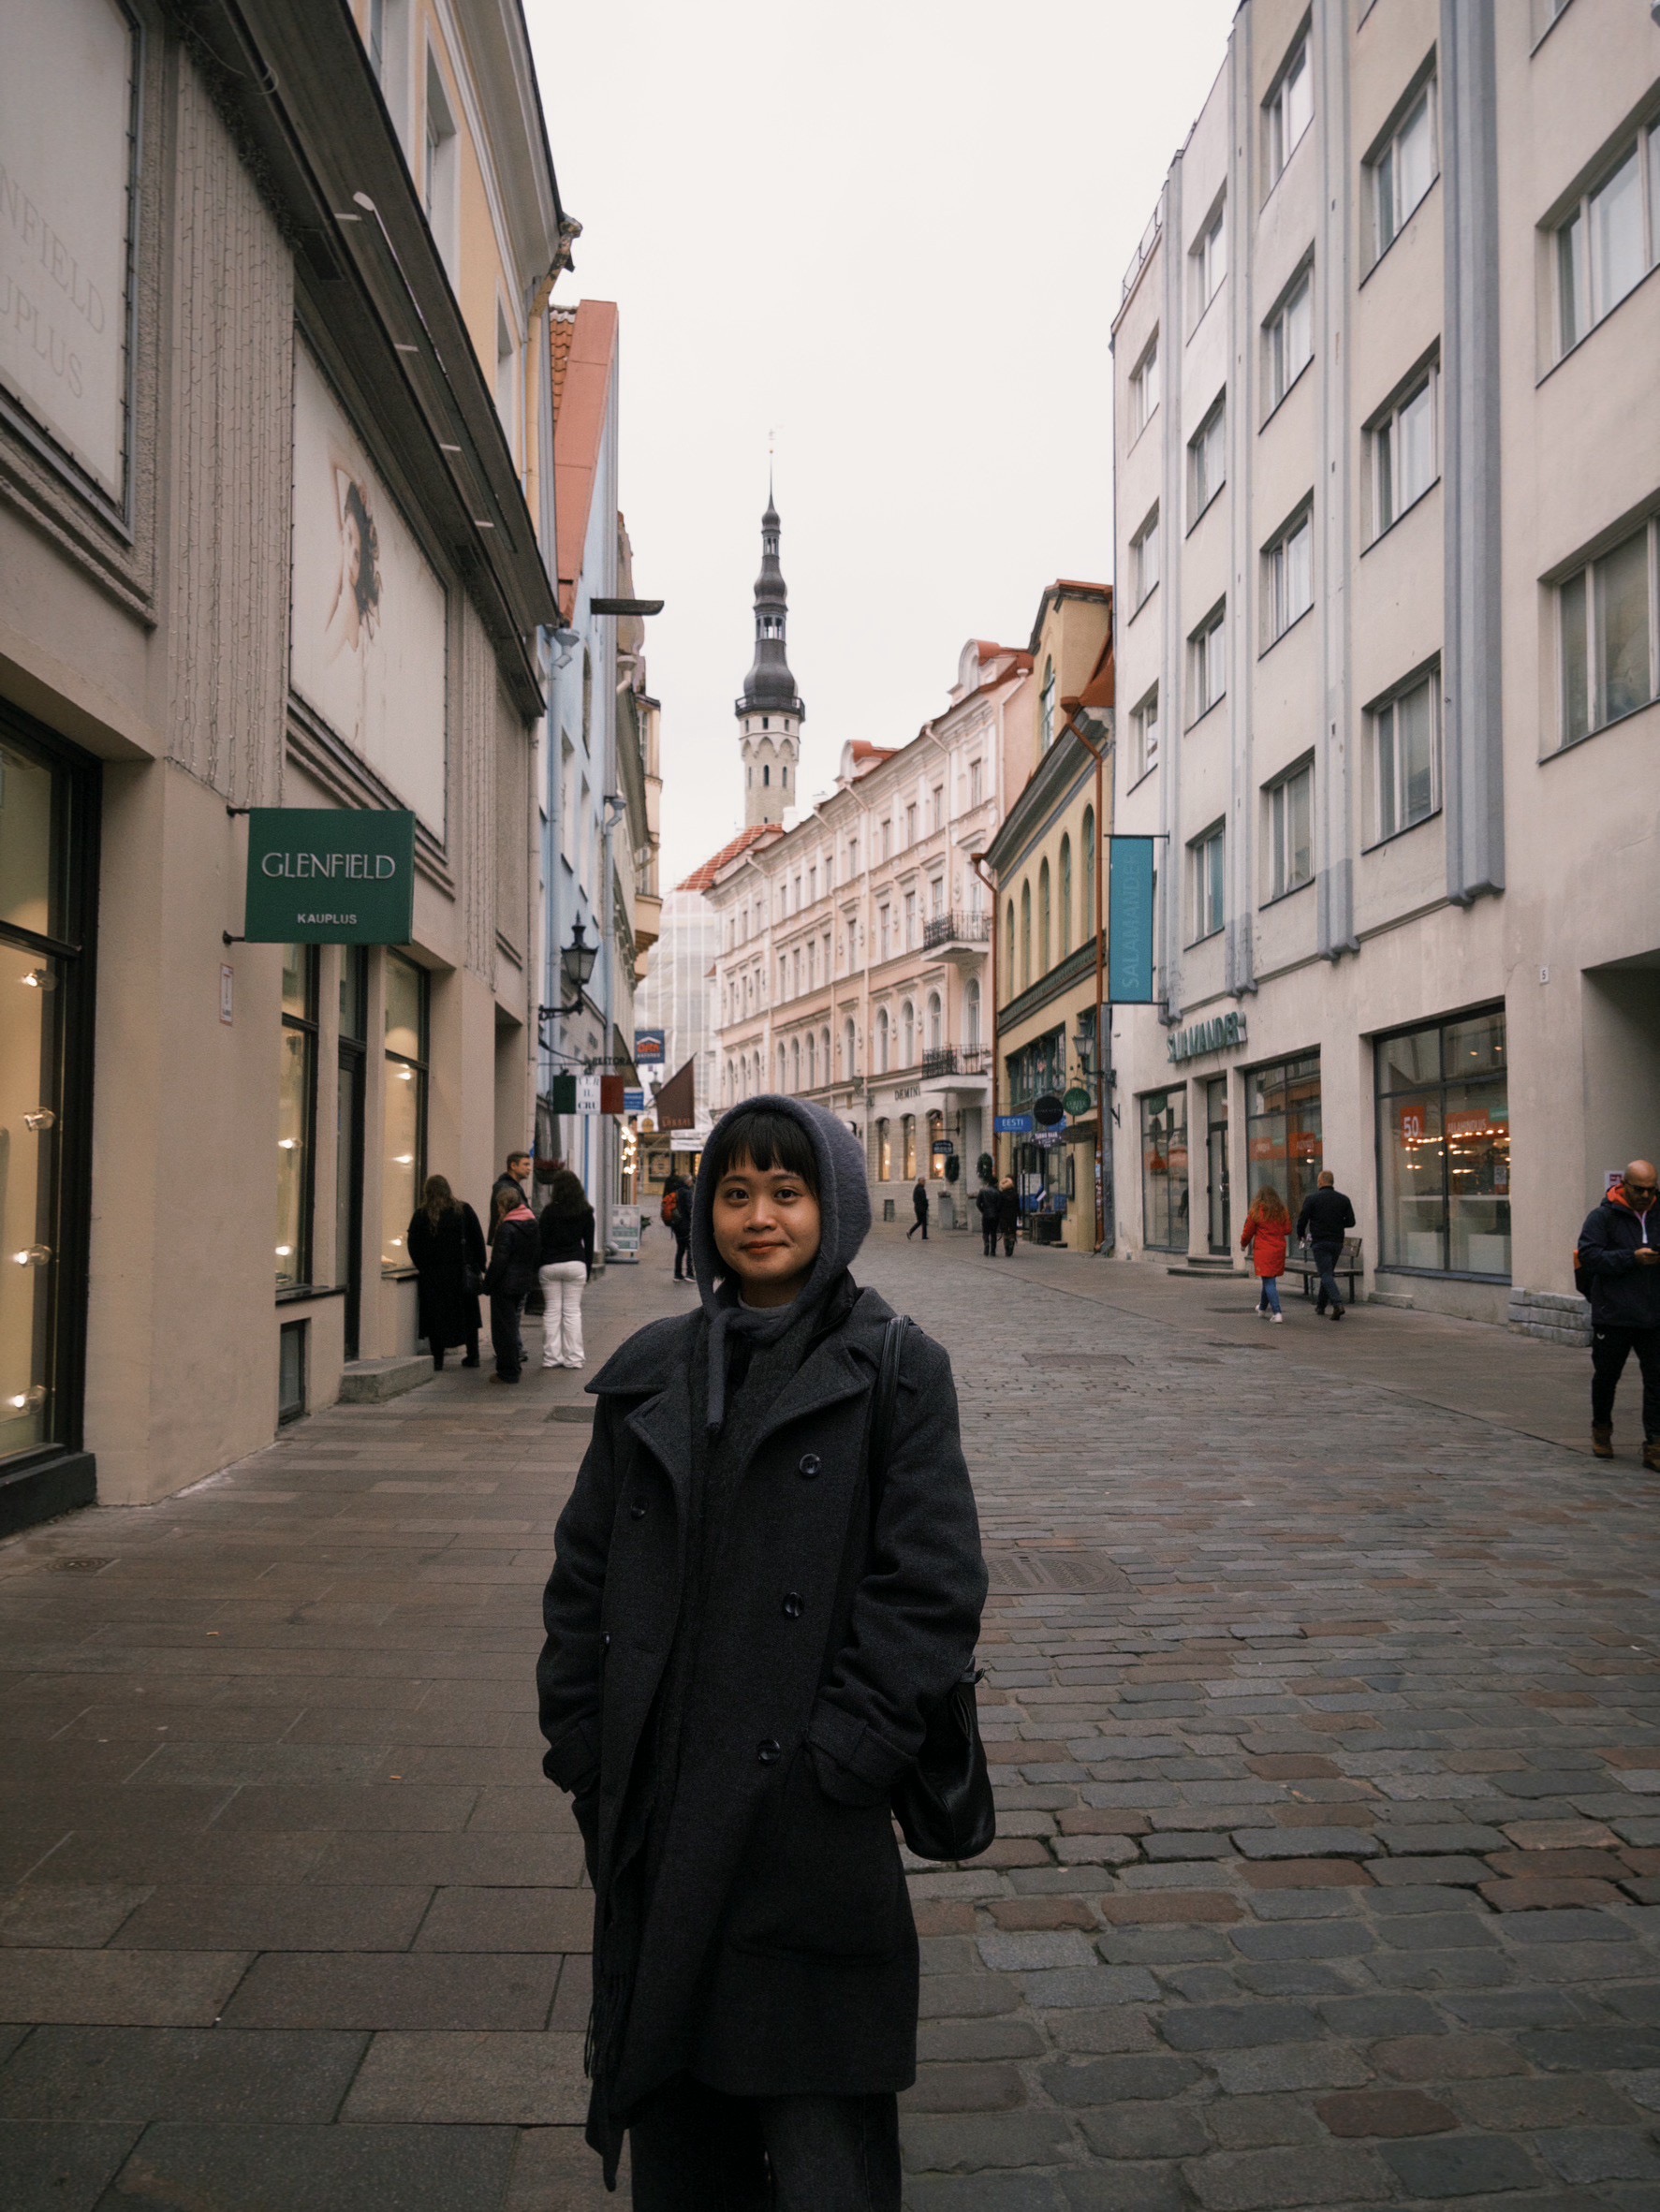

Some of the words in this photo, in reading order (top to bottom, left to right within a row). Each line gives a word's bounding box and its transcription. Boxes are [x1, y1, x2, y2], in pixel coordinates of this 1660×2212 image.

[261, 852, 396, 880] GLENFIELD
[297, 913, 358, 925] KAUPLUS
[1122, 853, 1140, 989] SALAMANDER
[578, 1101, 597, 1110] CRU
[1002, 1118, 1023, 1127] EESTI
[1403, 1116, 1418, 1138] 50
